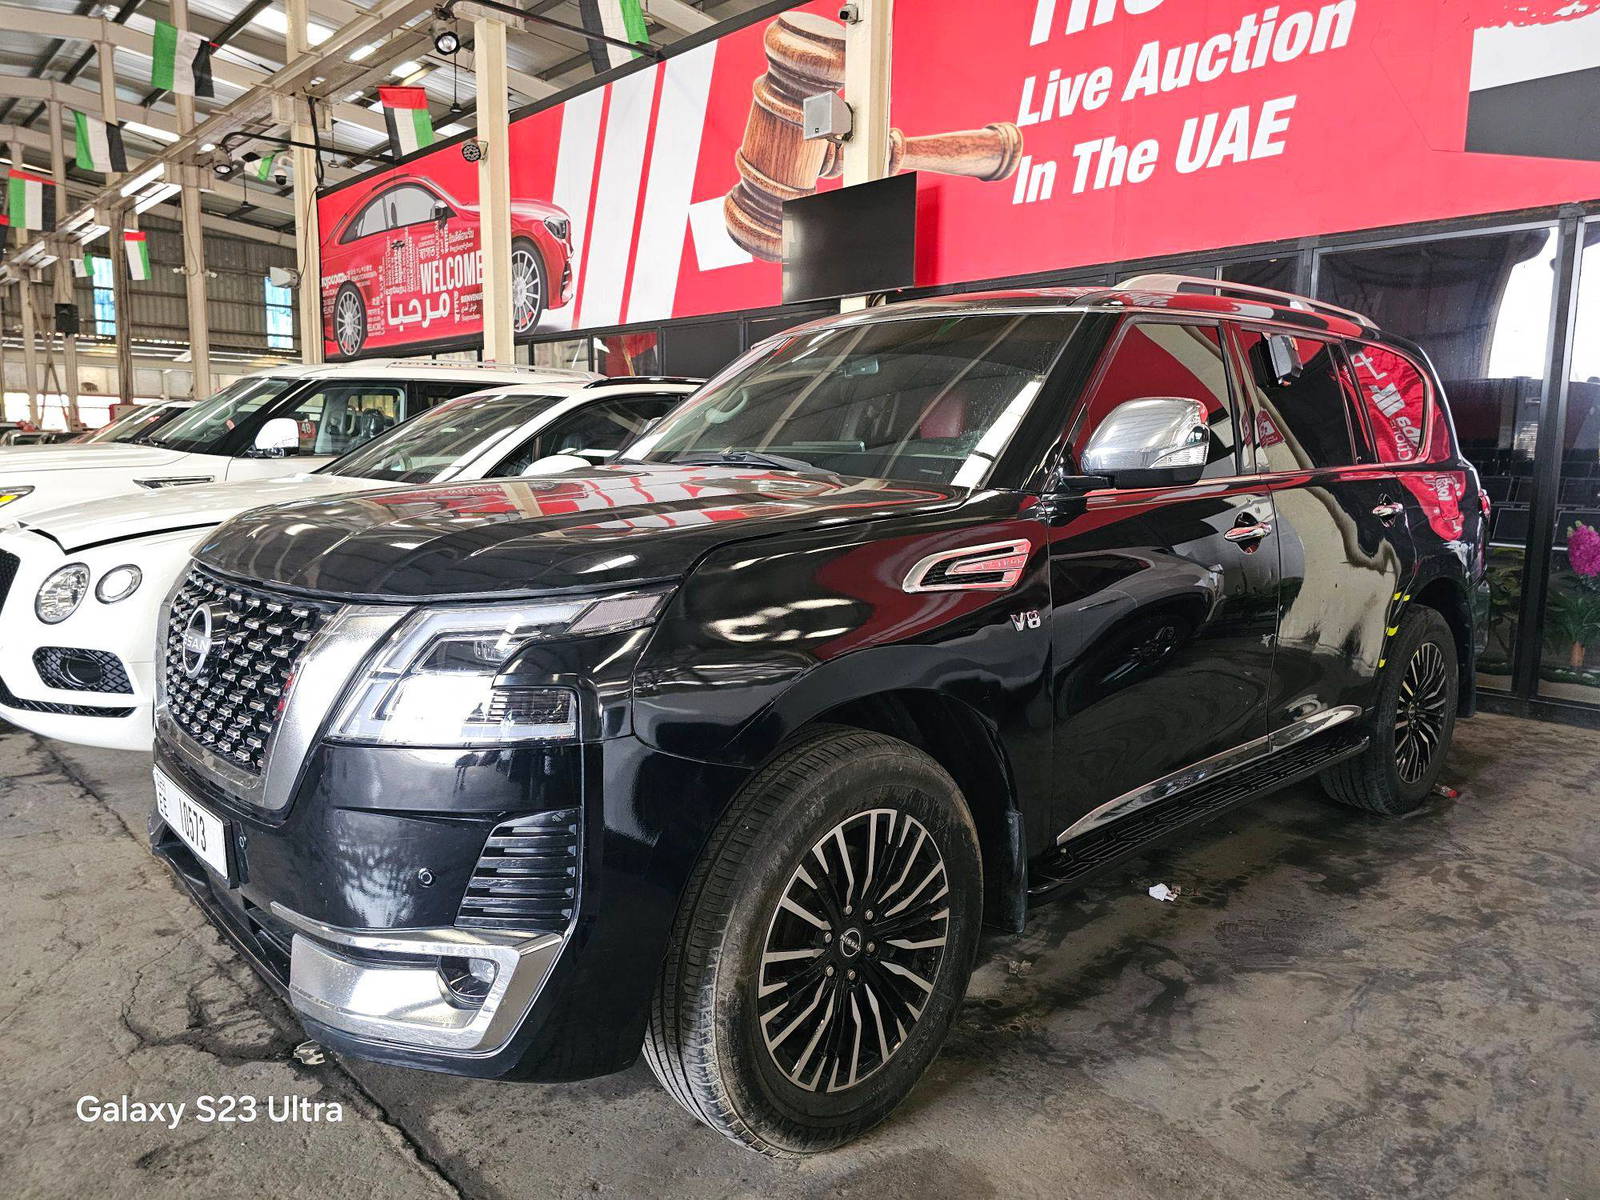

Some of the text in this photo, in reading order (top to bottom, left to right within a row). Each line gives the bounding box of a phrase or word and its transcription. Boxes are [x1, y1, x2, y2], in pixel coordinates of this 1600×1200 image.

[1016, 0, 1357, 128] Live Auction
[1012, 94, 1297, 205] In The UAE
[420, 250, 484, 295] WELCOME
[387, 292, 450, 332] مرحبا
[1010, 610, 1041, 632] V8
[178, 797, 207, 852] 10573
